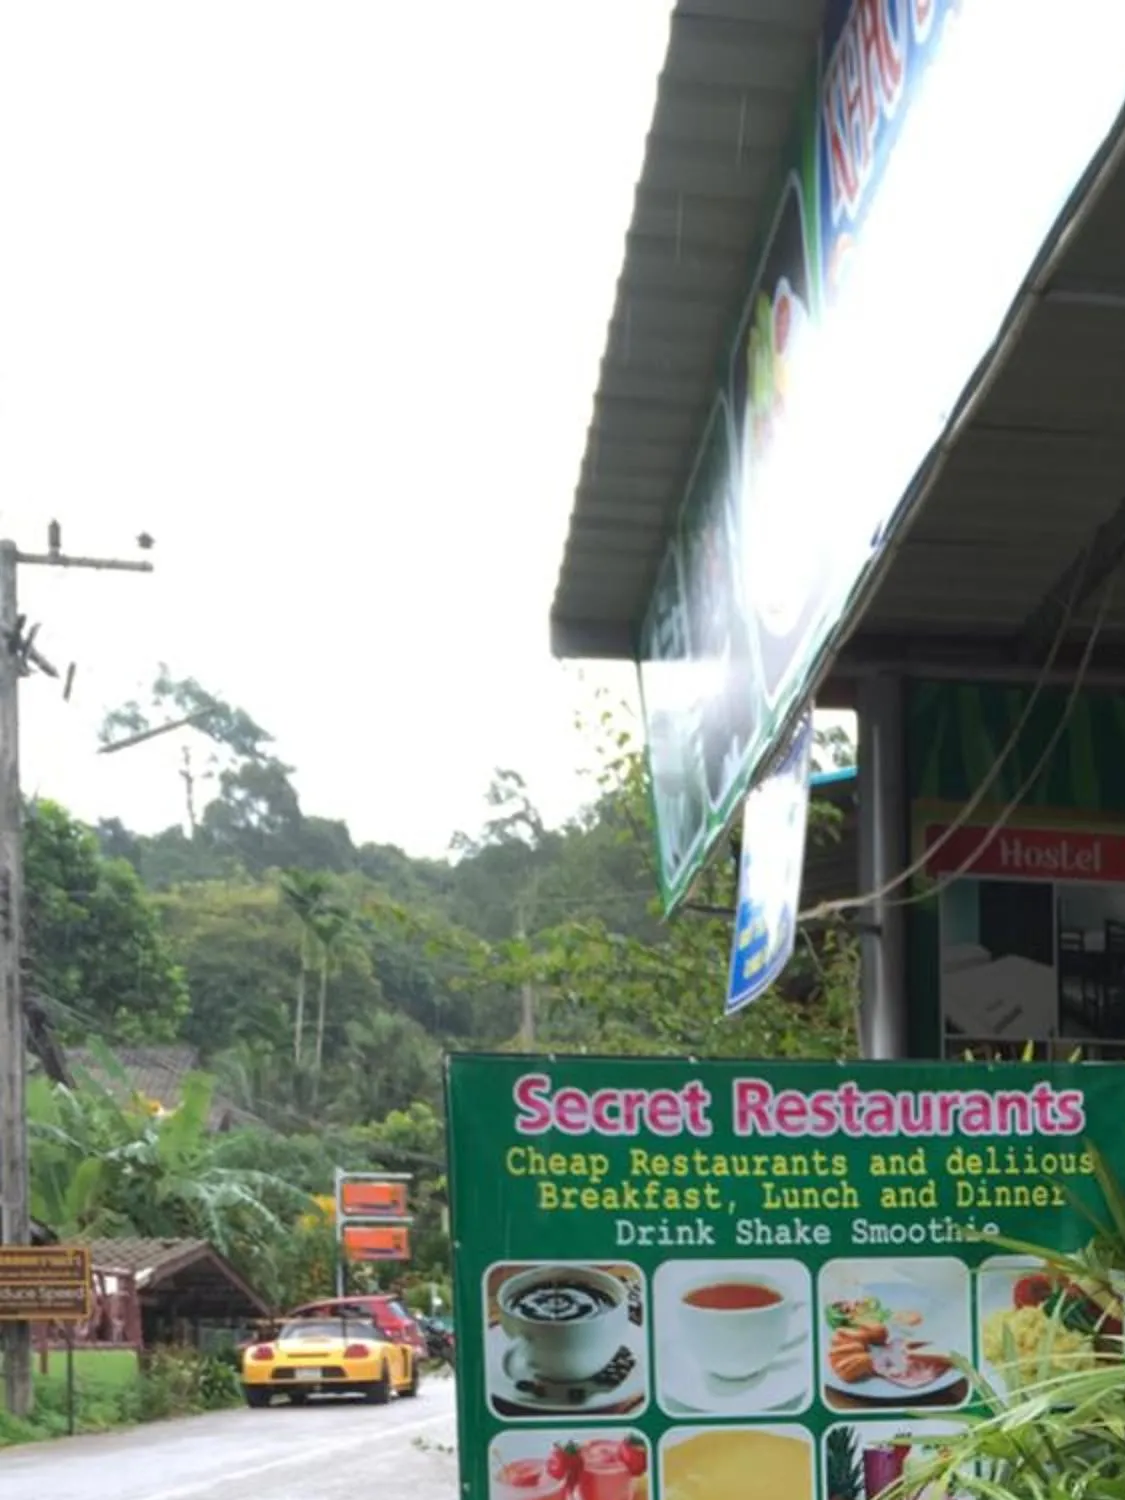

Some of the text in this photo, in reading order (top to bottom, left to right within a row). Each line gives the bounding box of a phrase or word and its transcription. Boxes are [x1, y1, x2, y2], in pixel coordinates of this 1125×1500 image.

[999, 839, 1103, 876] Hostel
[514, 1075, 1086, 1138] Secret Restaurants
[506, 1145, 1096, 1178] Cheap Restaurants and deliious
[538, 1179, 1068, 1215] Breakfast, Lunch and Dinner
[615, 1219, 716, 1247] Drink
[734, 1217, 832, 1246] Shake
